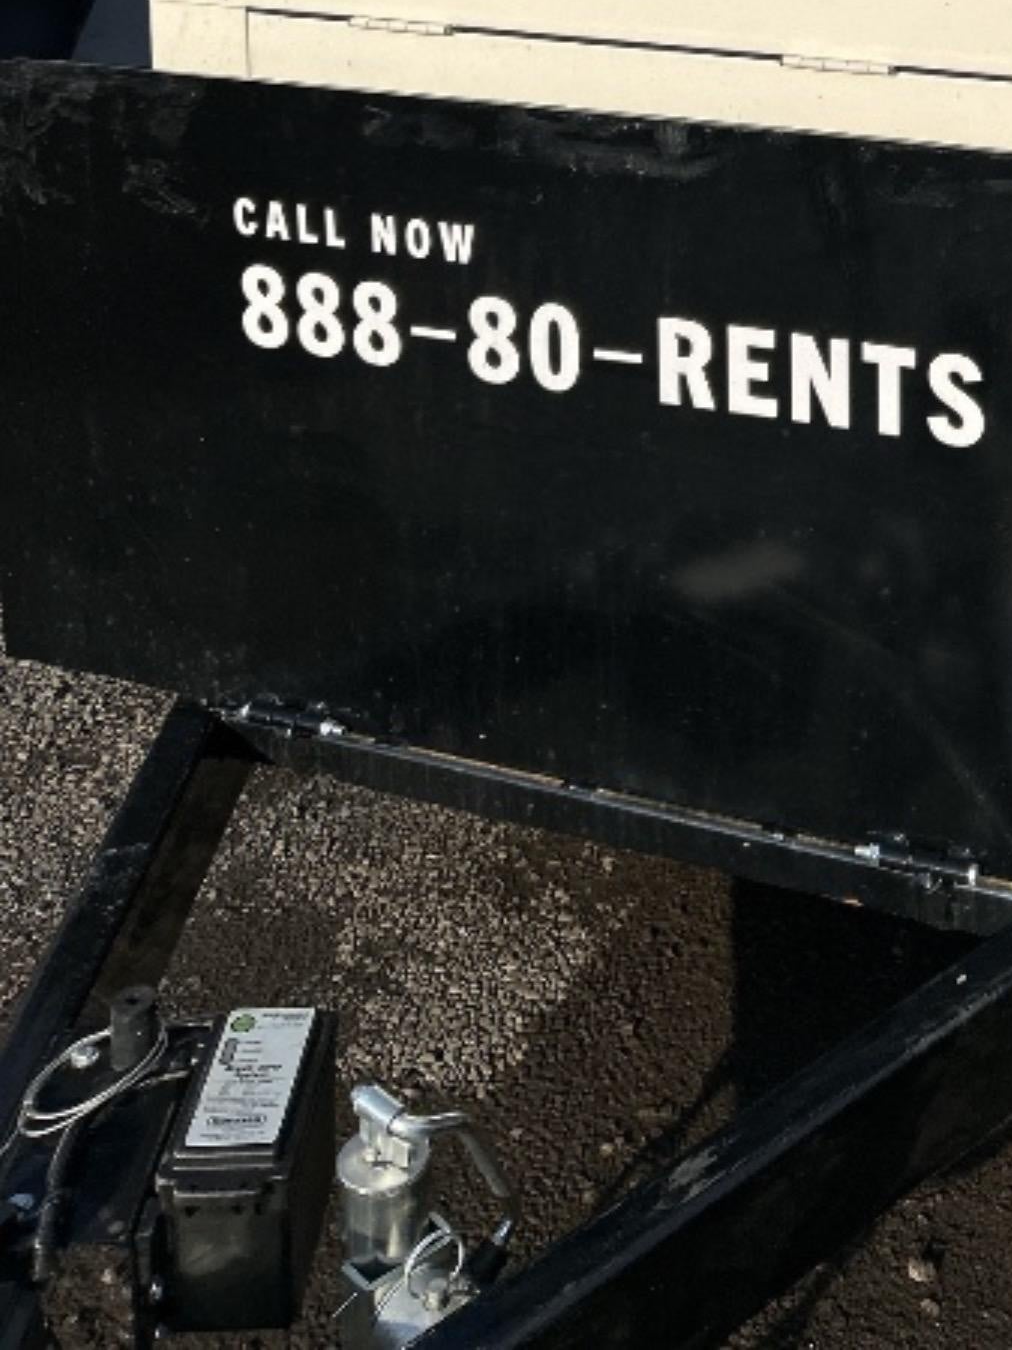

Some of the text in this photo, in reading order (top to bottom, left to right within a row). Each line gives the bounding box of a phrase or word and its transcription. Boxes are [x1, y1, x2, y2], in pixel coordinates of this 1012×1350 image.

[232, 196, 476, 266] CALL NOW
[239, 262, 987, 449] 888-80-RENTS
